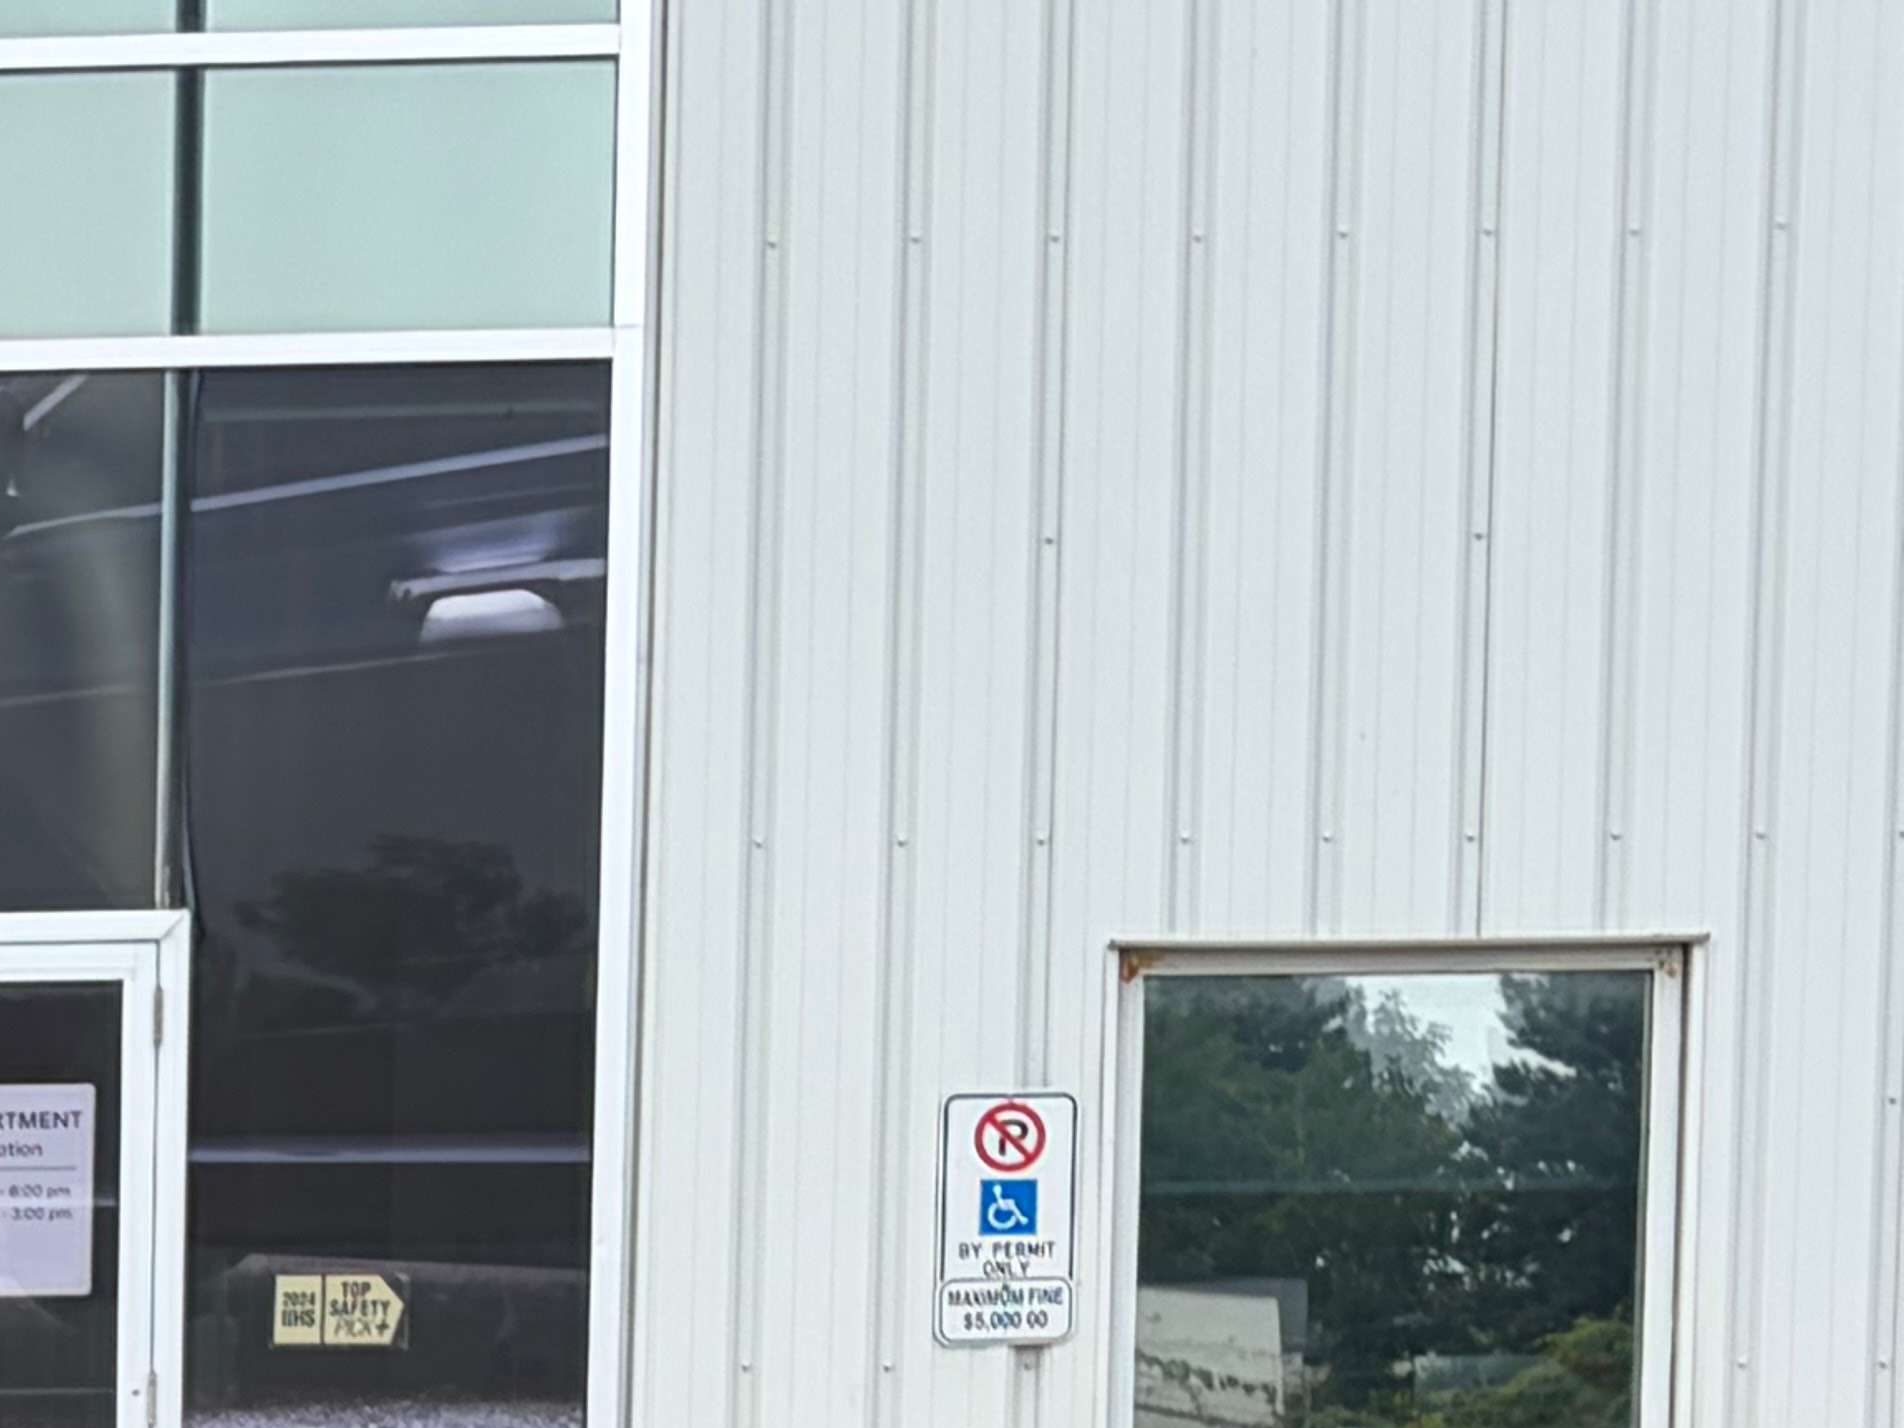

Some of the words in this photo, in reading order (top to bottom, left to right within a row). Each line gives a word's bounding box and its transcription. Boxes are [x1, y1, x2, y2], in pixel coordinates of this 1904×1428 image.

[958, 1243, 982, 1260] BY
[992, 1241, 1056, 1258] PERMIT
[983, 1261, 1030, 1278] ONLY
[341, 1281, 372, 1298] TOP
[947, 1285, 1025, 1307] MAXIMUM
[1028, 1286, 1064, 1306] FINE
[329, 1299, 391, 1317] SAFETY
